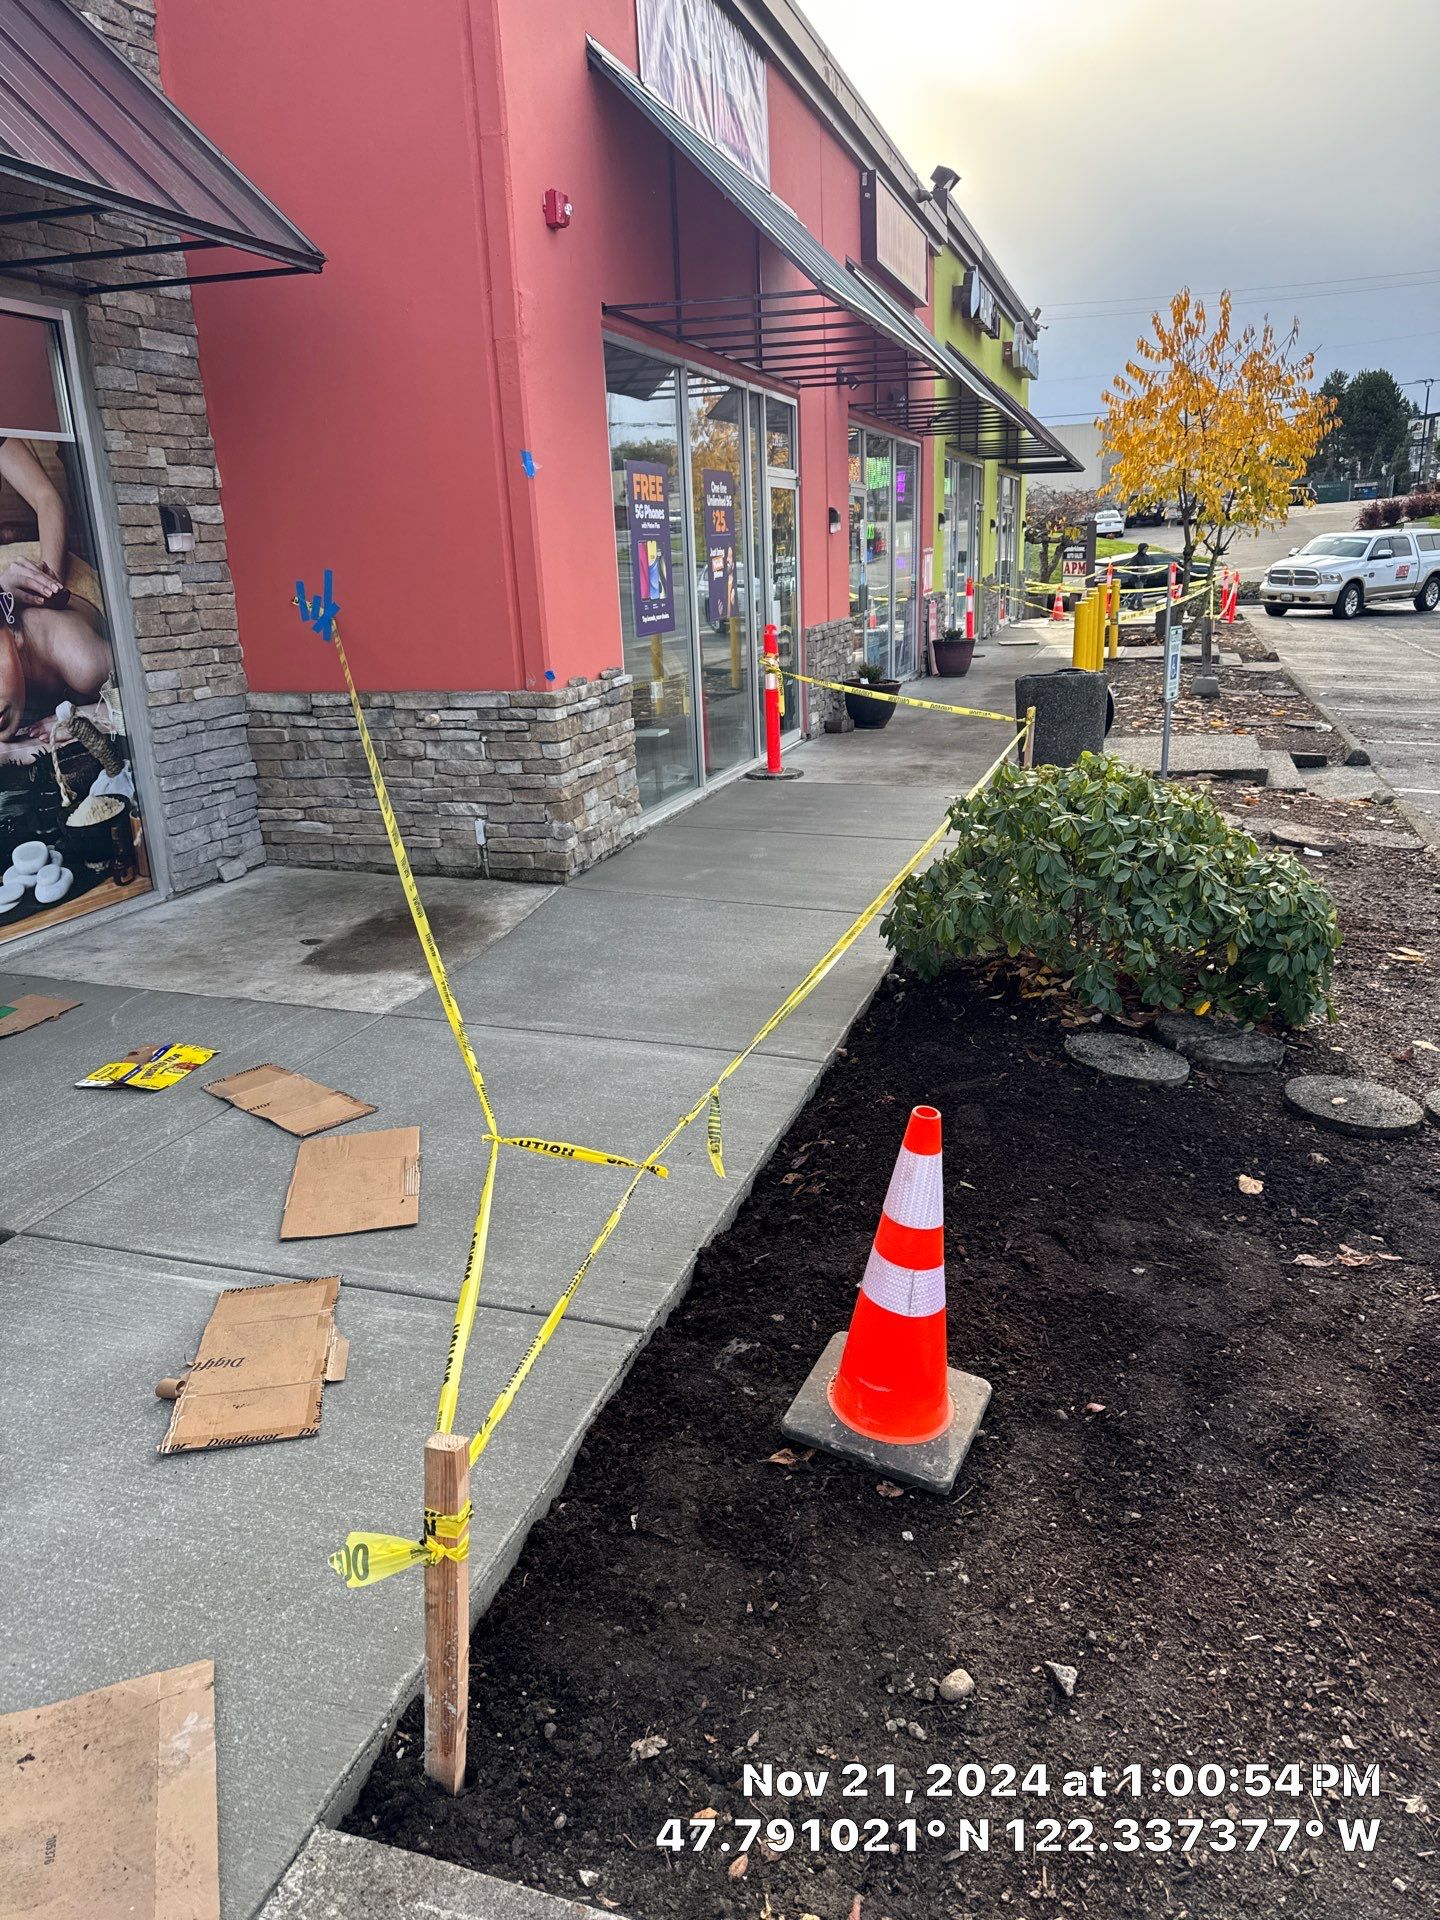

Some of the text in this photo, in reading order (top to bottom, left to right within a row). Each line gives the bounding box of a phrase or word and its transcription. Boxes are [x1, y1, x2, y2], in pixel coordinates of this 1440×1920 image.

[633, 473, 664, 502] FREE
[635, 504, 665, 519] 5G Phones
